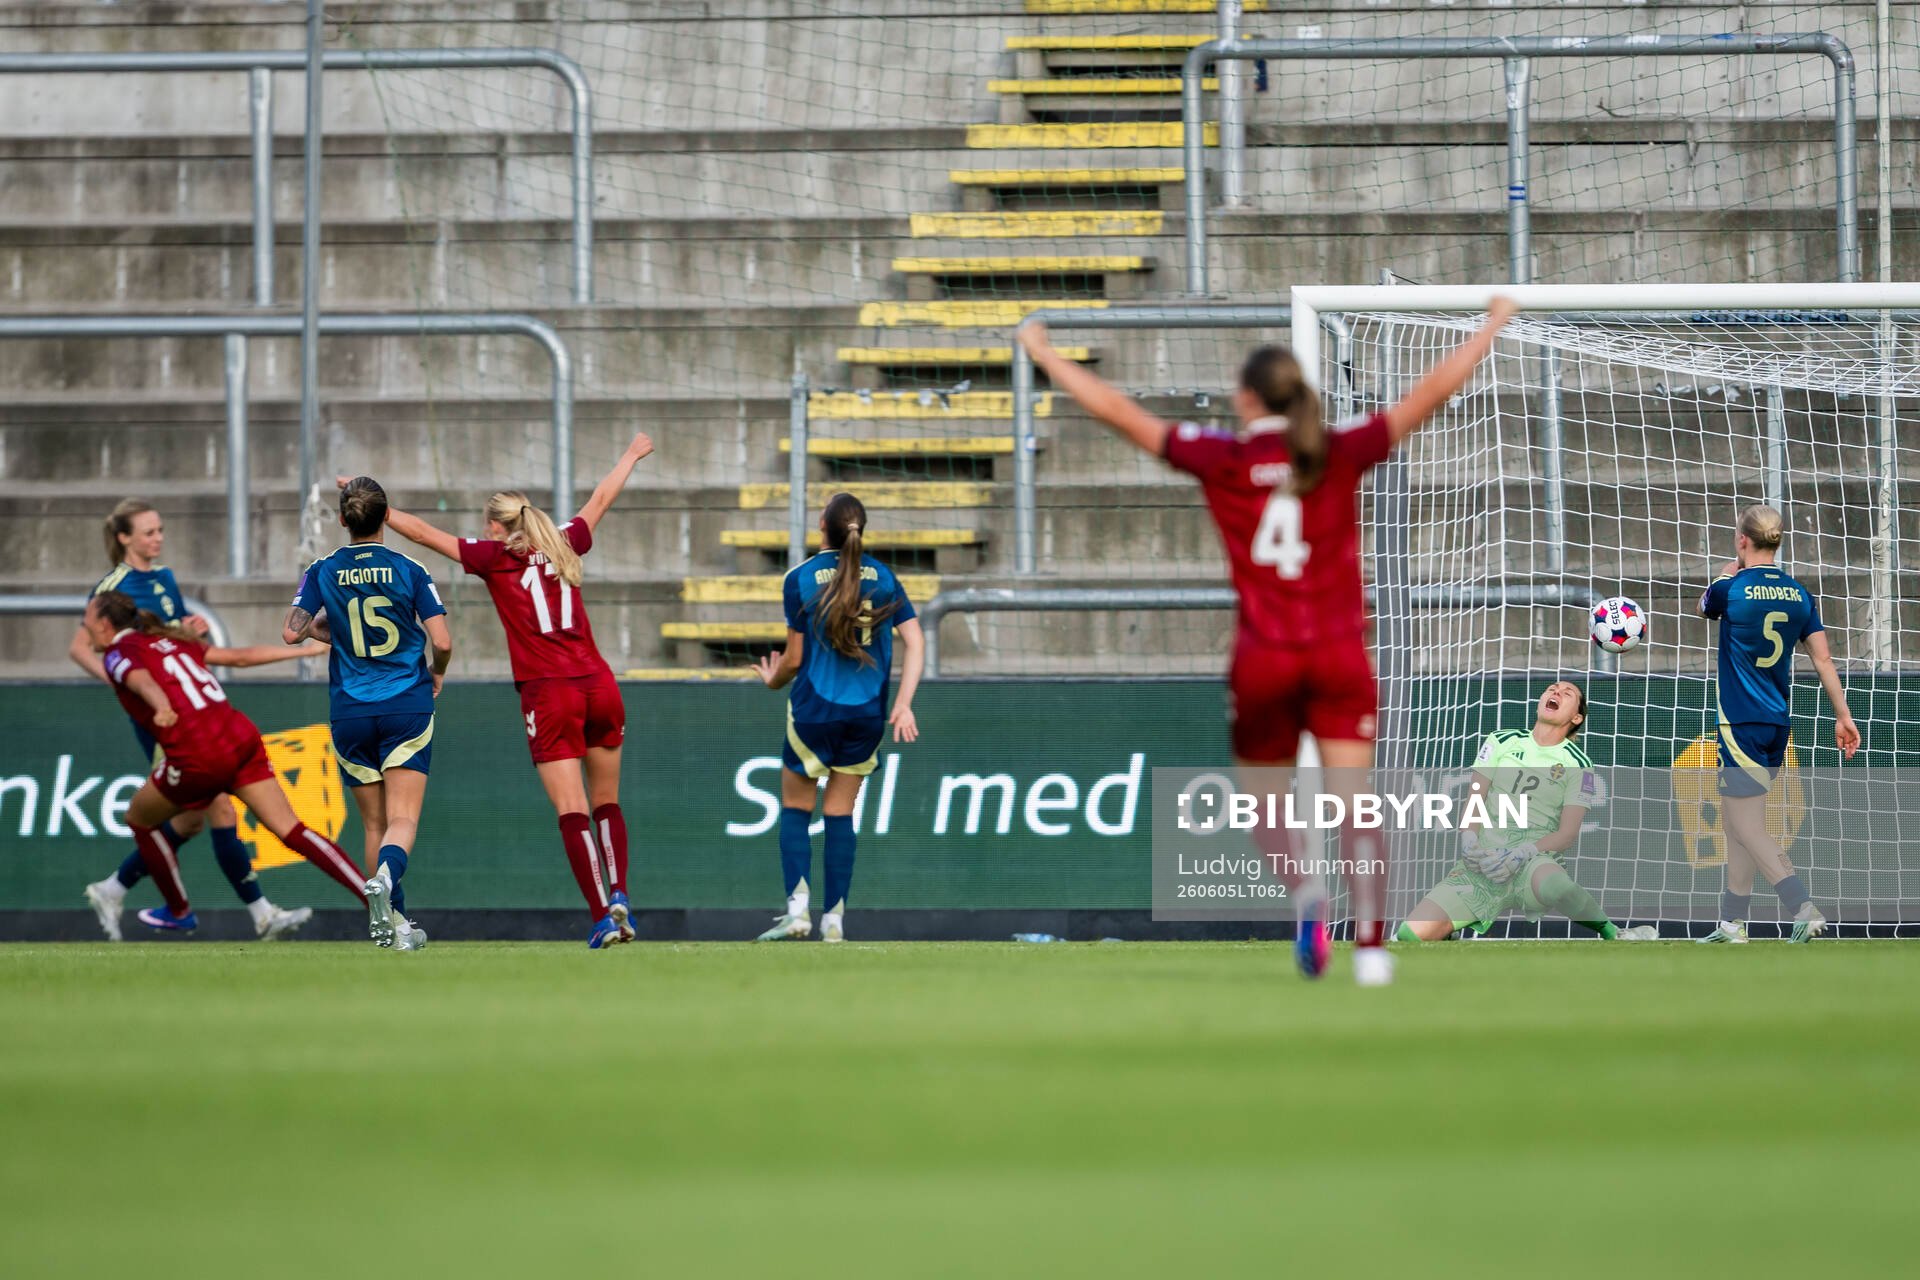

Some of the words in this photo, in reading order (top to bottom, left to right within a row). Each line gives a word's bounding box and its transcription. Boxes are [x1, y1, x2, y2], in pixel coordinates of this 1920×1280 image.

[1251, 492, 1312, 579] 4
[337, 567, 393, 586] ZIGIOTTI
[520, 562, 573, 634] 17
[1744, 585, 1803, 602] SANDBERG
[347, 595, 400, 657] 15
[1608, 599, 1621, 626] SELECT
[1755, 611, 1789, 668] 5
[162, 652, 227, 710] 19
[933, 752, 1146, 836] med
